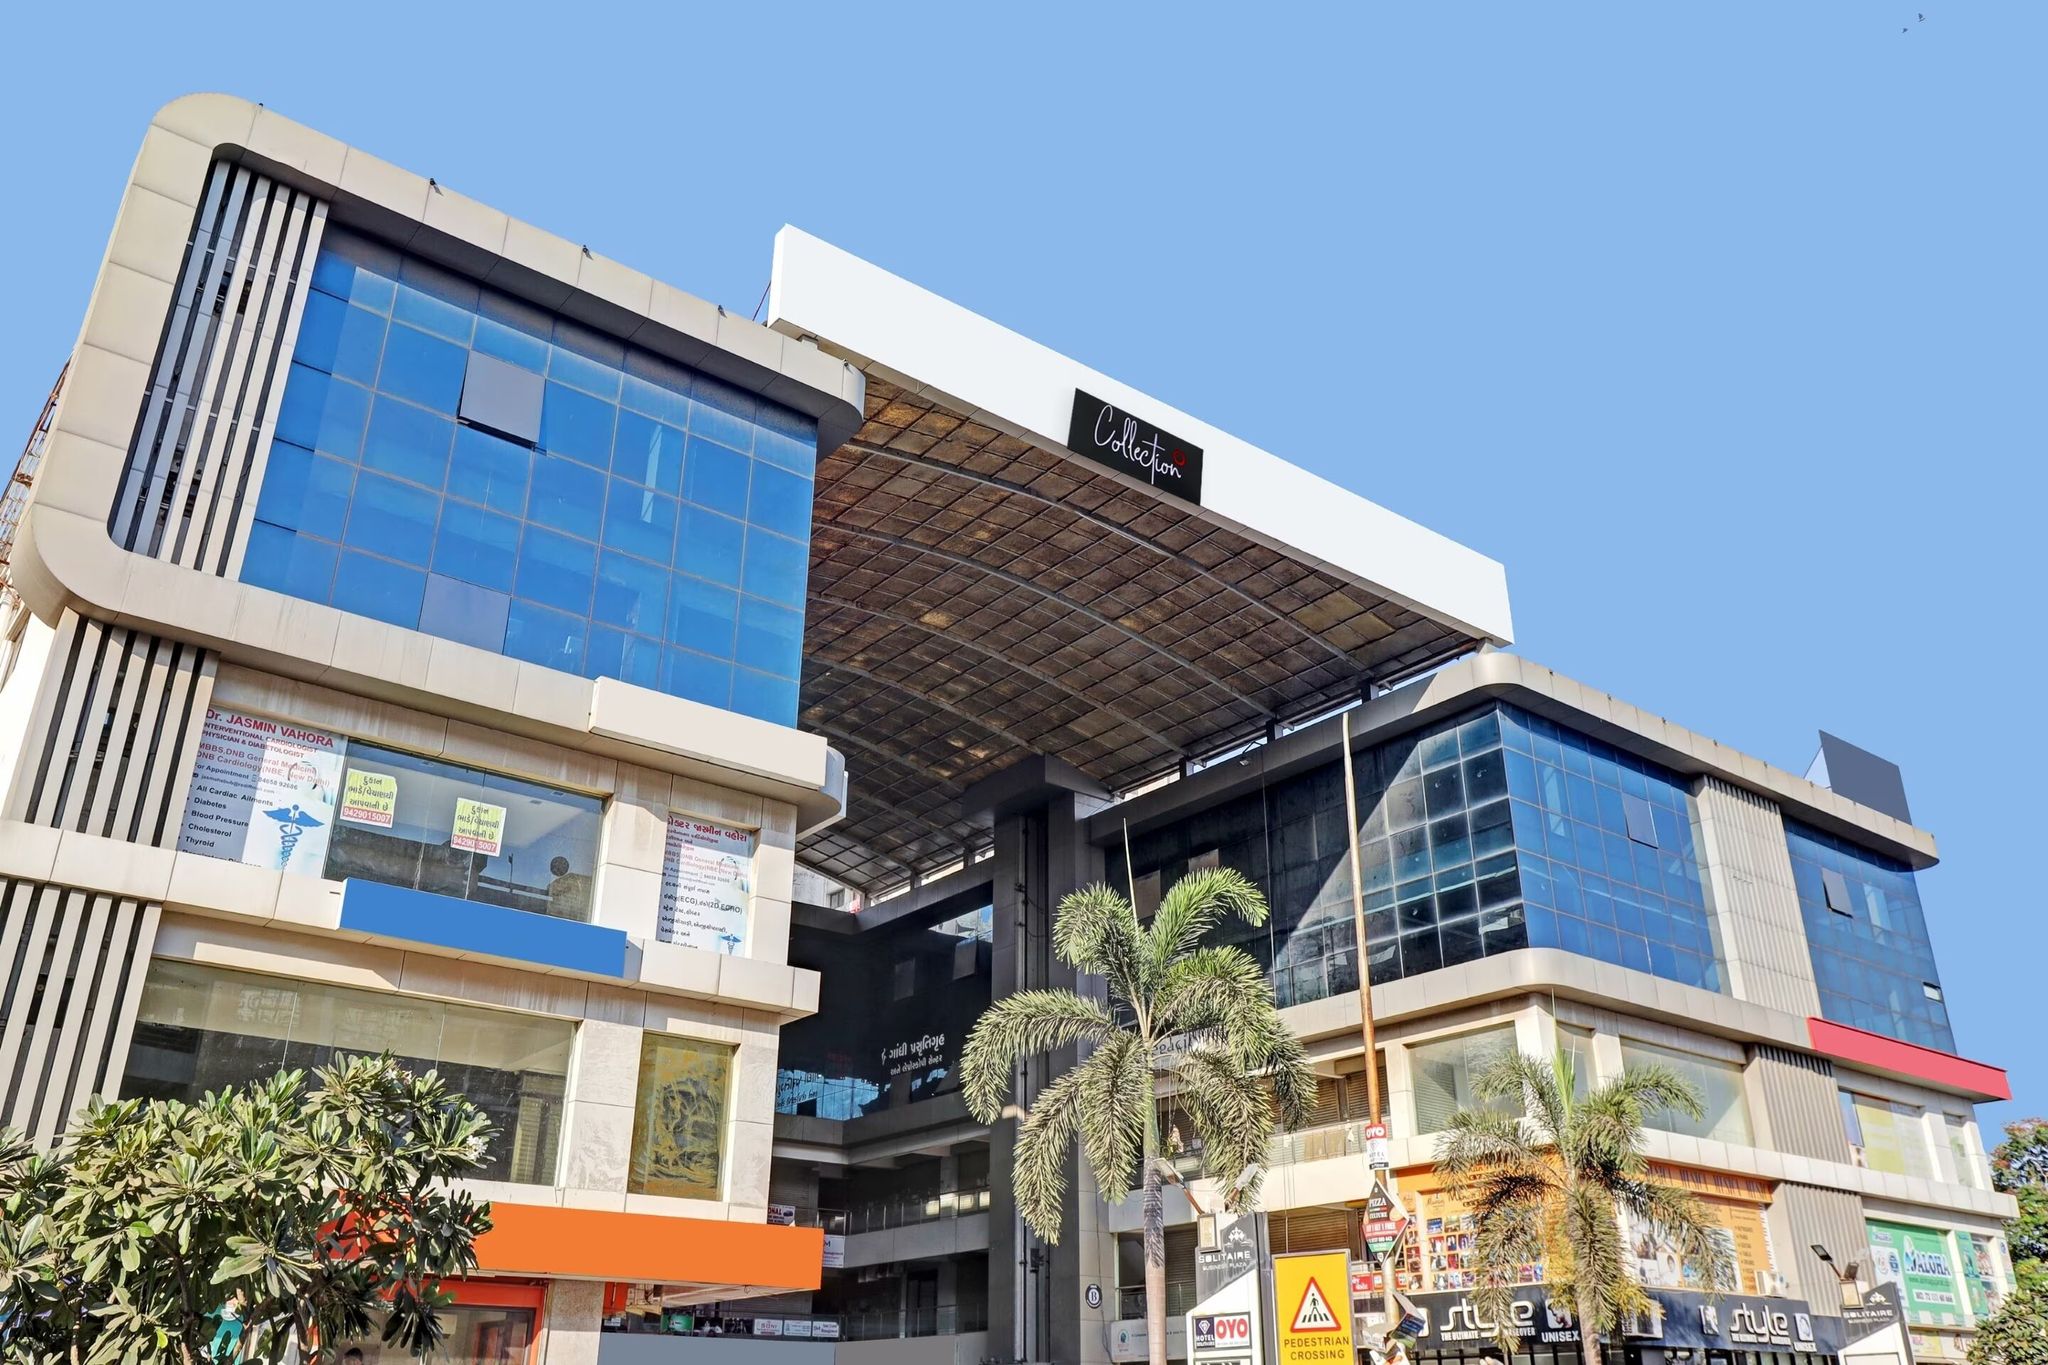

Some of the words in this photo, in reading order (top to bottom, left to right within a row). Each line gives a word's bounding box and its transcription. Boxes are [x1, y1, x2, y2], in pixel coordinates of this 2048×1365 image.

[1094, 404, 1182, 485] Collection
[206, 709, 222, 721] Dr.
[226, 715, 277, 734] JASMIN
[280, 726, 334, 748] VAHORA
[202, 729, 240, 744] PHYSICIAN
[247, 740, 305, 758] DIABETOLOGIST
[265, 736, 318, 753] CARDIOLOGIST
[247, 752, 280, 766] General
[206, 765, 250, 780] Appointment
[196, 784, 208, 793] All
[209, 787, 238, 799] Cardiac
[241, 794, 274, 807] Ailments
[194, 797, 228, 810] Diabetes
[191, 809, 214, 821] Blood
[215, 814, 249, 828] Pressure
[343, 807, 391, 823] 9429015007
[188, 823, 232, 838] Cholesterol
[185, 836, 216, 849] Thyroid
[888, 1042, 908, 1059] ગાંધી
[1366, 1126, 1386, 1138] OYO
[1198, 1250, 1251, 1264] SOLITAIRE
[1842, 1309, 1894, 1319] SOLITAIRE
[1215, 1317, 1249, 1340] OYO
[1730, 1302, 1789, 1343] style
[1284, 1336, 1350, 1348] PEDESTRIAN
[1541, 1330, 1581, 1343] UNISEX
[1290, 1349, 1345, 1361] CROSSING
